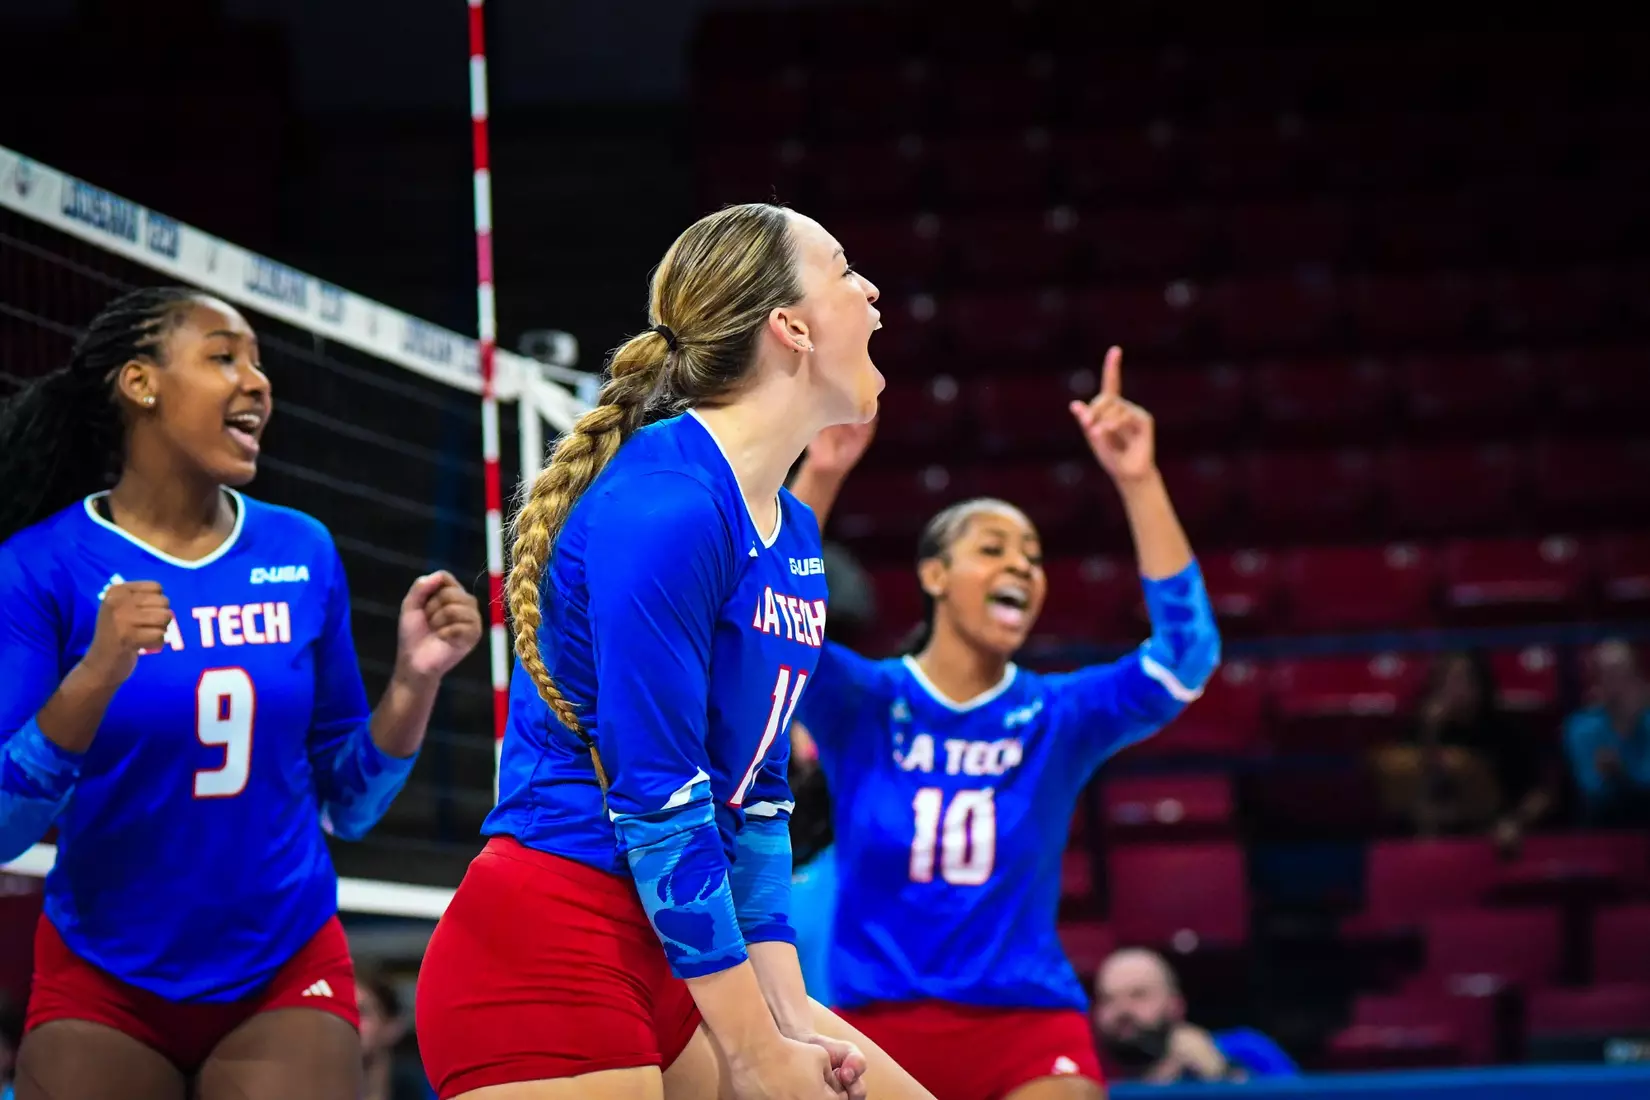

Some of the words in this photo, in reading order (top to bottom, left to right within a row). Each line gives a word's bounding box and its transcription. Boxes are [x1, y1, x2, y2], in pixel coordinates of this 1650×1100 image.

[138, 610, 185, 655] A
[192, 602, 291, 648] TECH
[192, 666, 256, 800] 9
[909, 785, 996, 886] 10
